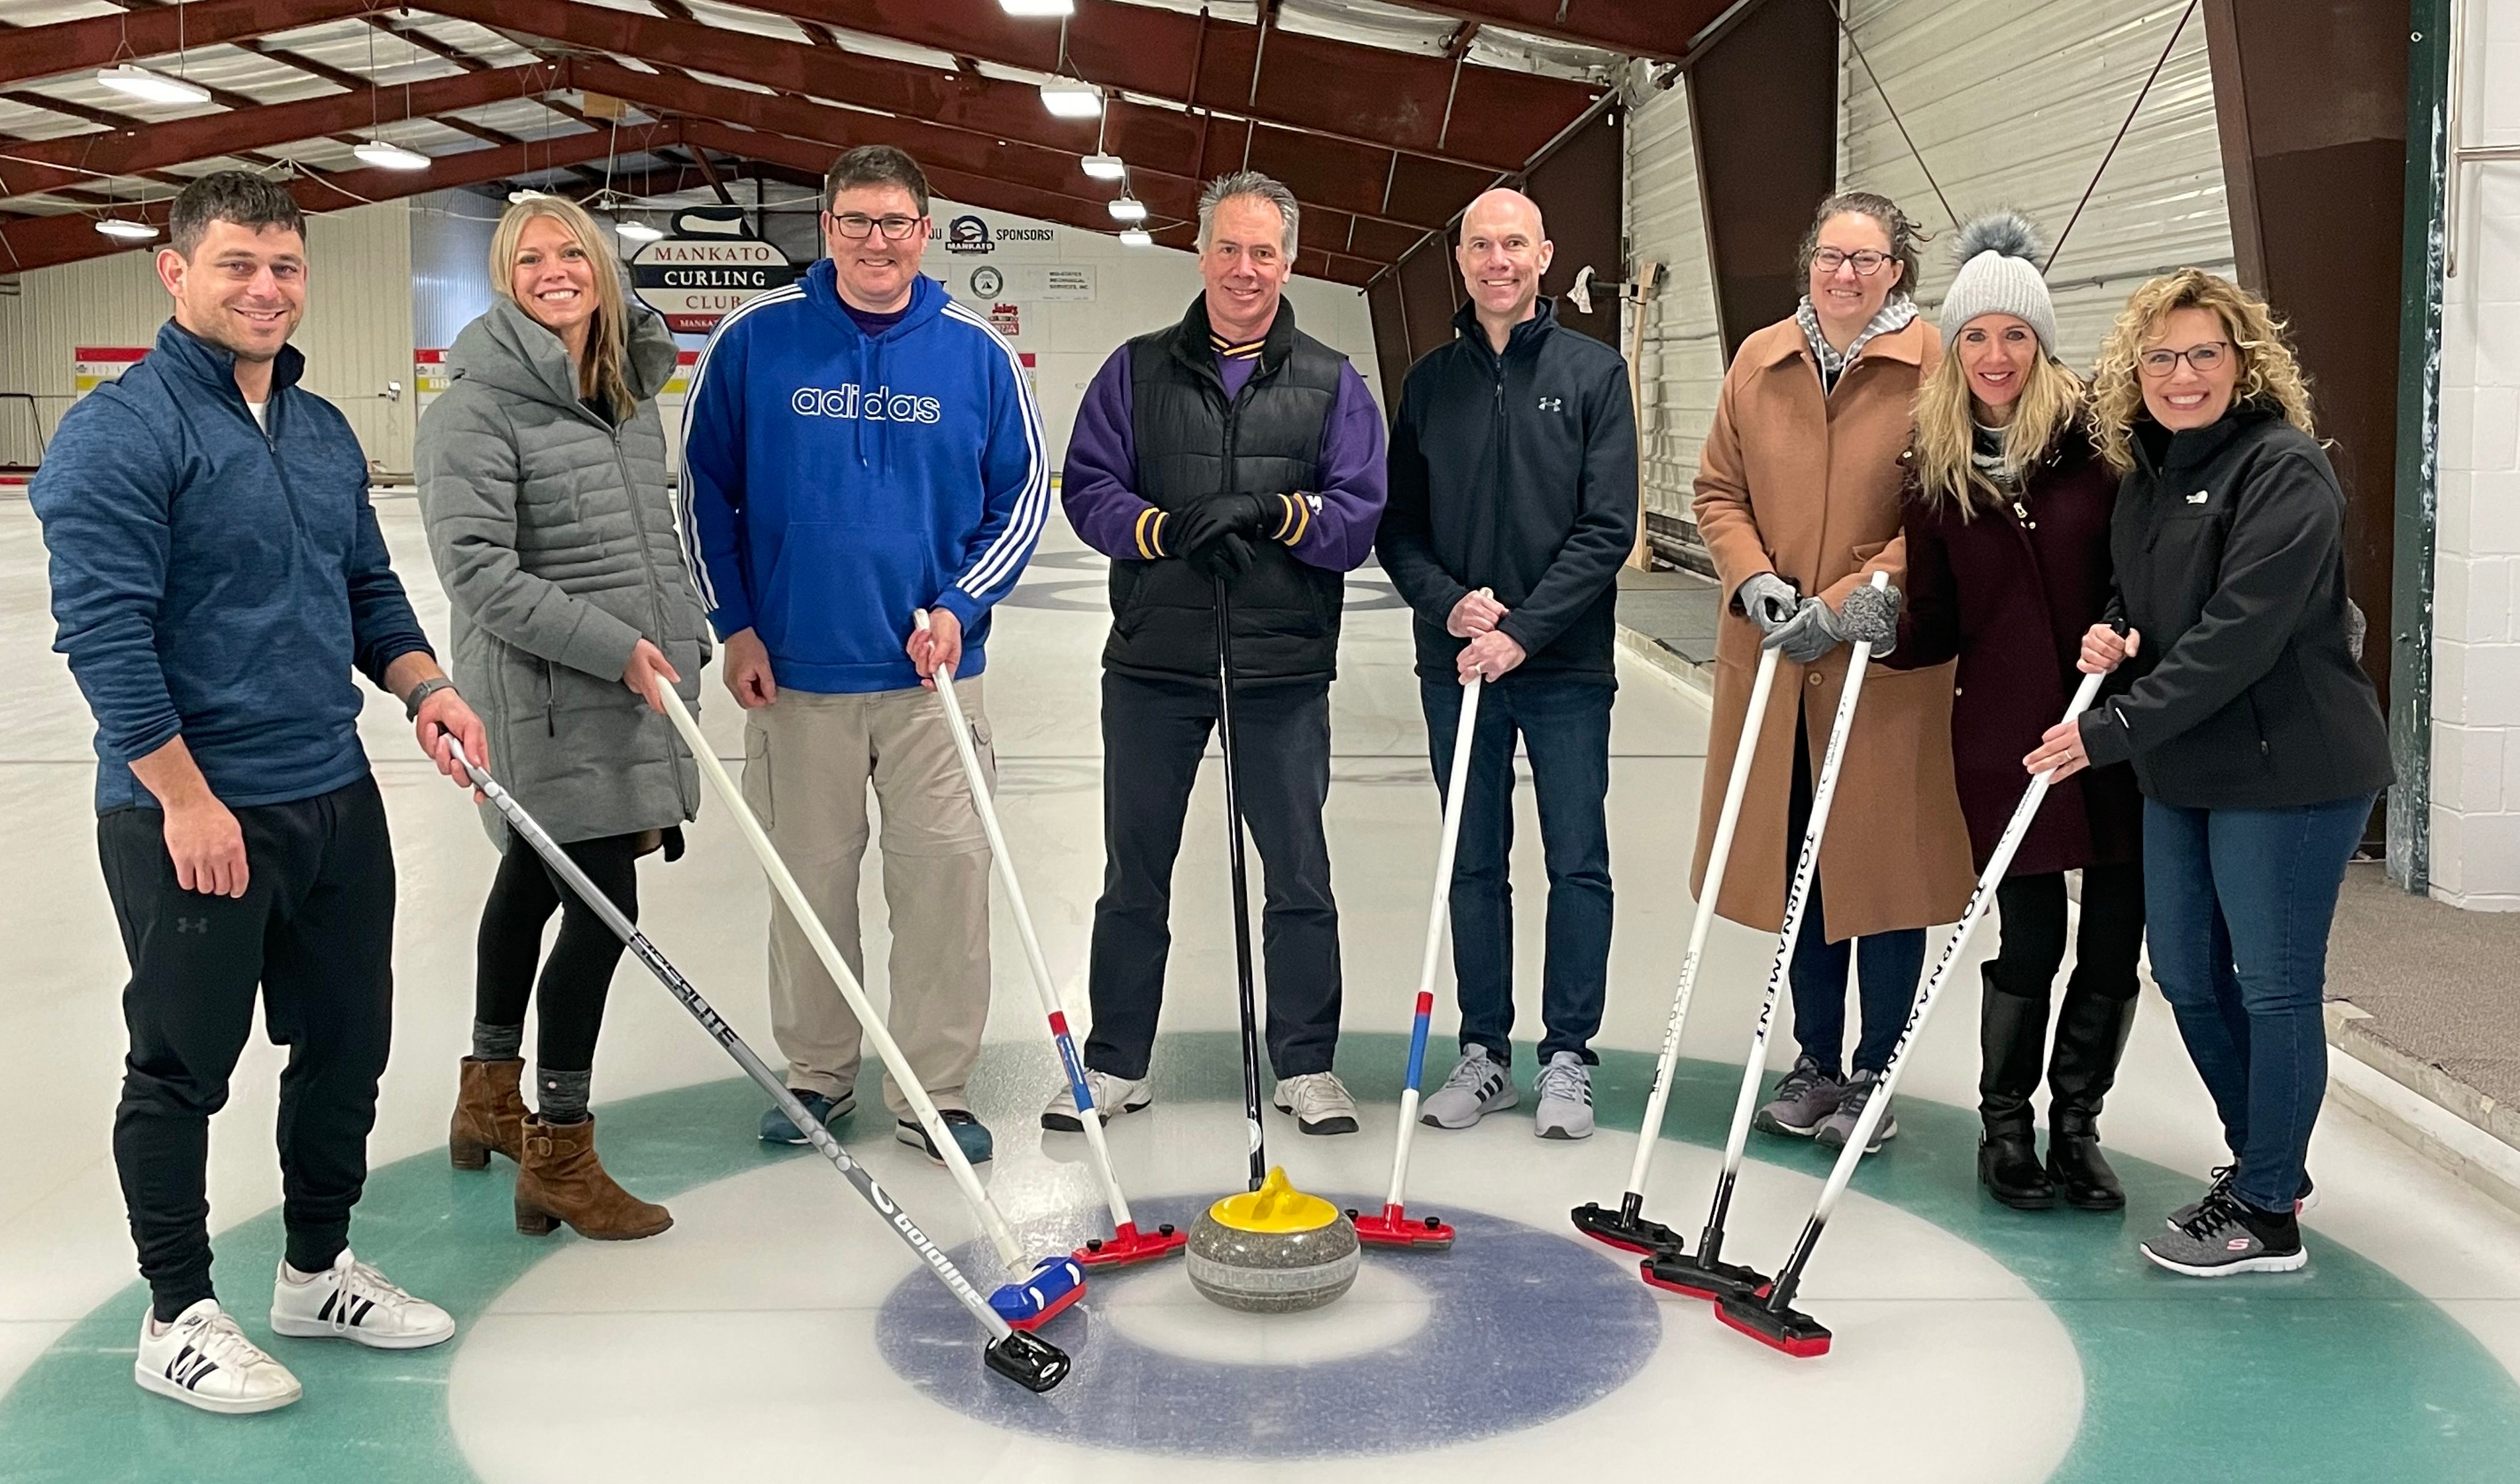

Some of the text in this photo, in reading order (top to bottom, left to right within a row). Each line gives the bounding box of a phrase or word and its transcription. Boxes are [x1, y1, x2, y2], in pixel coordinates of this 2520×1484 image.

[996, 229, 1053, 241] SPONSORS!
[655, 246, 770, 261] MANKATO
[664, 271, 766, 286] CURLING
[686, 295, 741, 309] CLUB
[792, 383, 941, 424] adidas
[1754, 831, 1818, 1045] TOURNAMENT
[1877, 882, 1987, 1094] TOURNAMENT
[894, 1212, 984, 1308] Goldline
